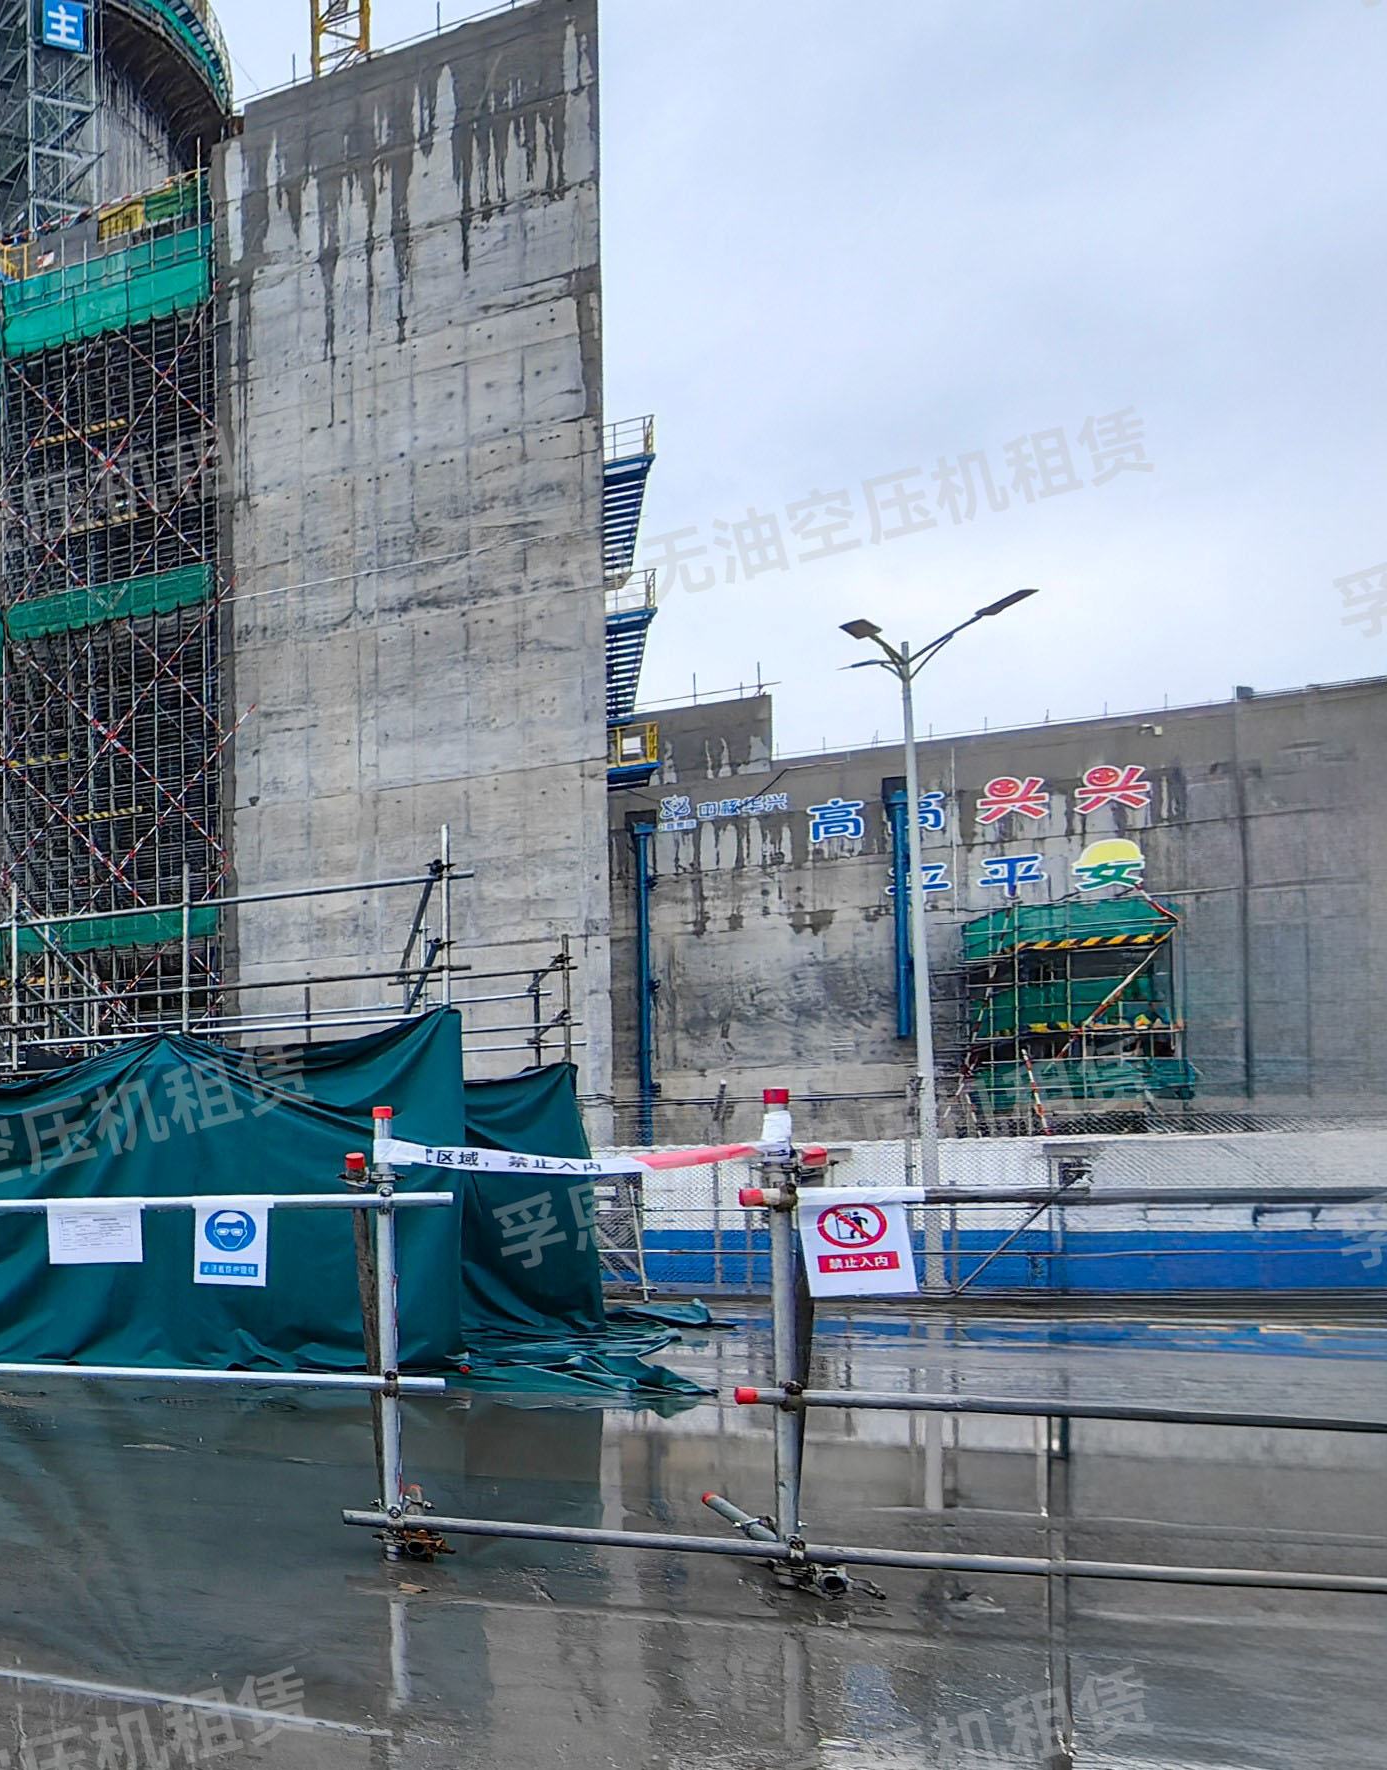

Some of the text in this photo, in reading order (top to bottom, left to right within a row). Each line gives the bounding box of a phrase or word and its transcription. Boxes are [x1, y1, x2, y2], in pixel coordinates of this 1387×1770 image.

[46, 4, 80, 47] 主
[828, 1256, 889, 1269] 禁止入内
